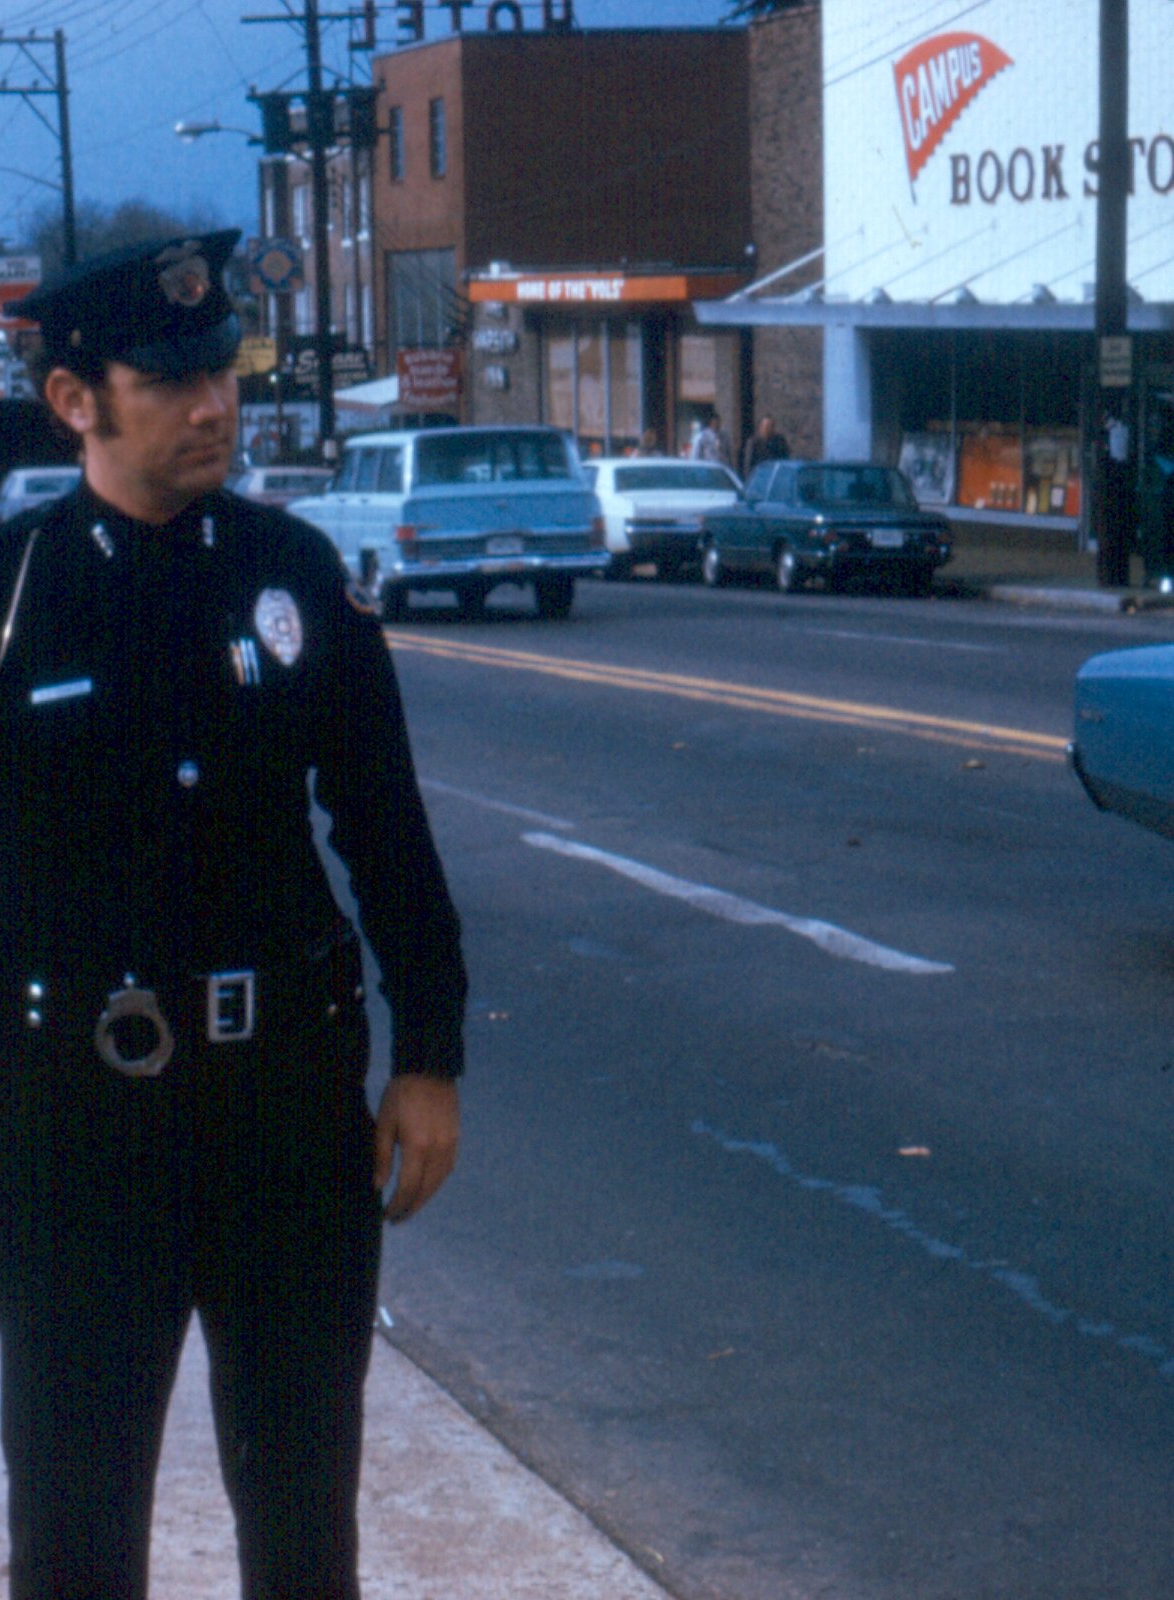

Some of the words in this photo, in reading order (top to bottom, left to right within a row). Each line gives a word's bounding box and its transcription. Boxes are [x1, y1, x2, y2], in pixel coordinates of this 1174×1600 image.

[902, 42, 982, 151] CAMPUS
[949, 146, 1069, 204] BOOK
[548, 280, 563, 300] OF
[564, 280, 586, 299] THE
